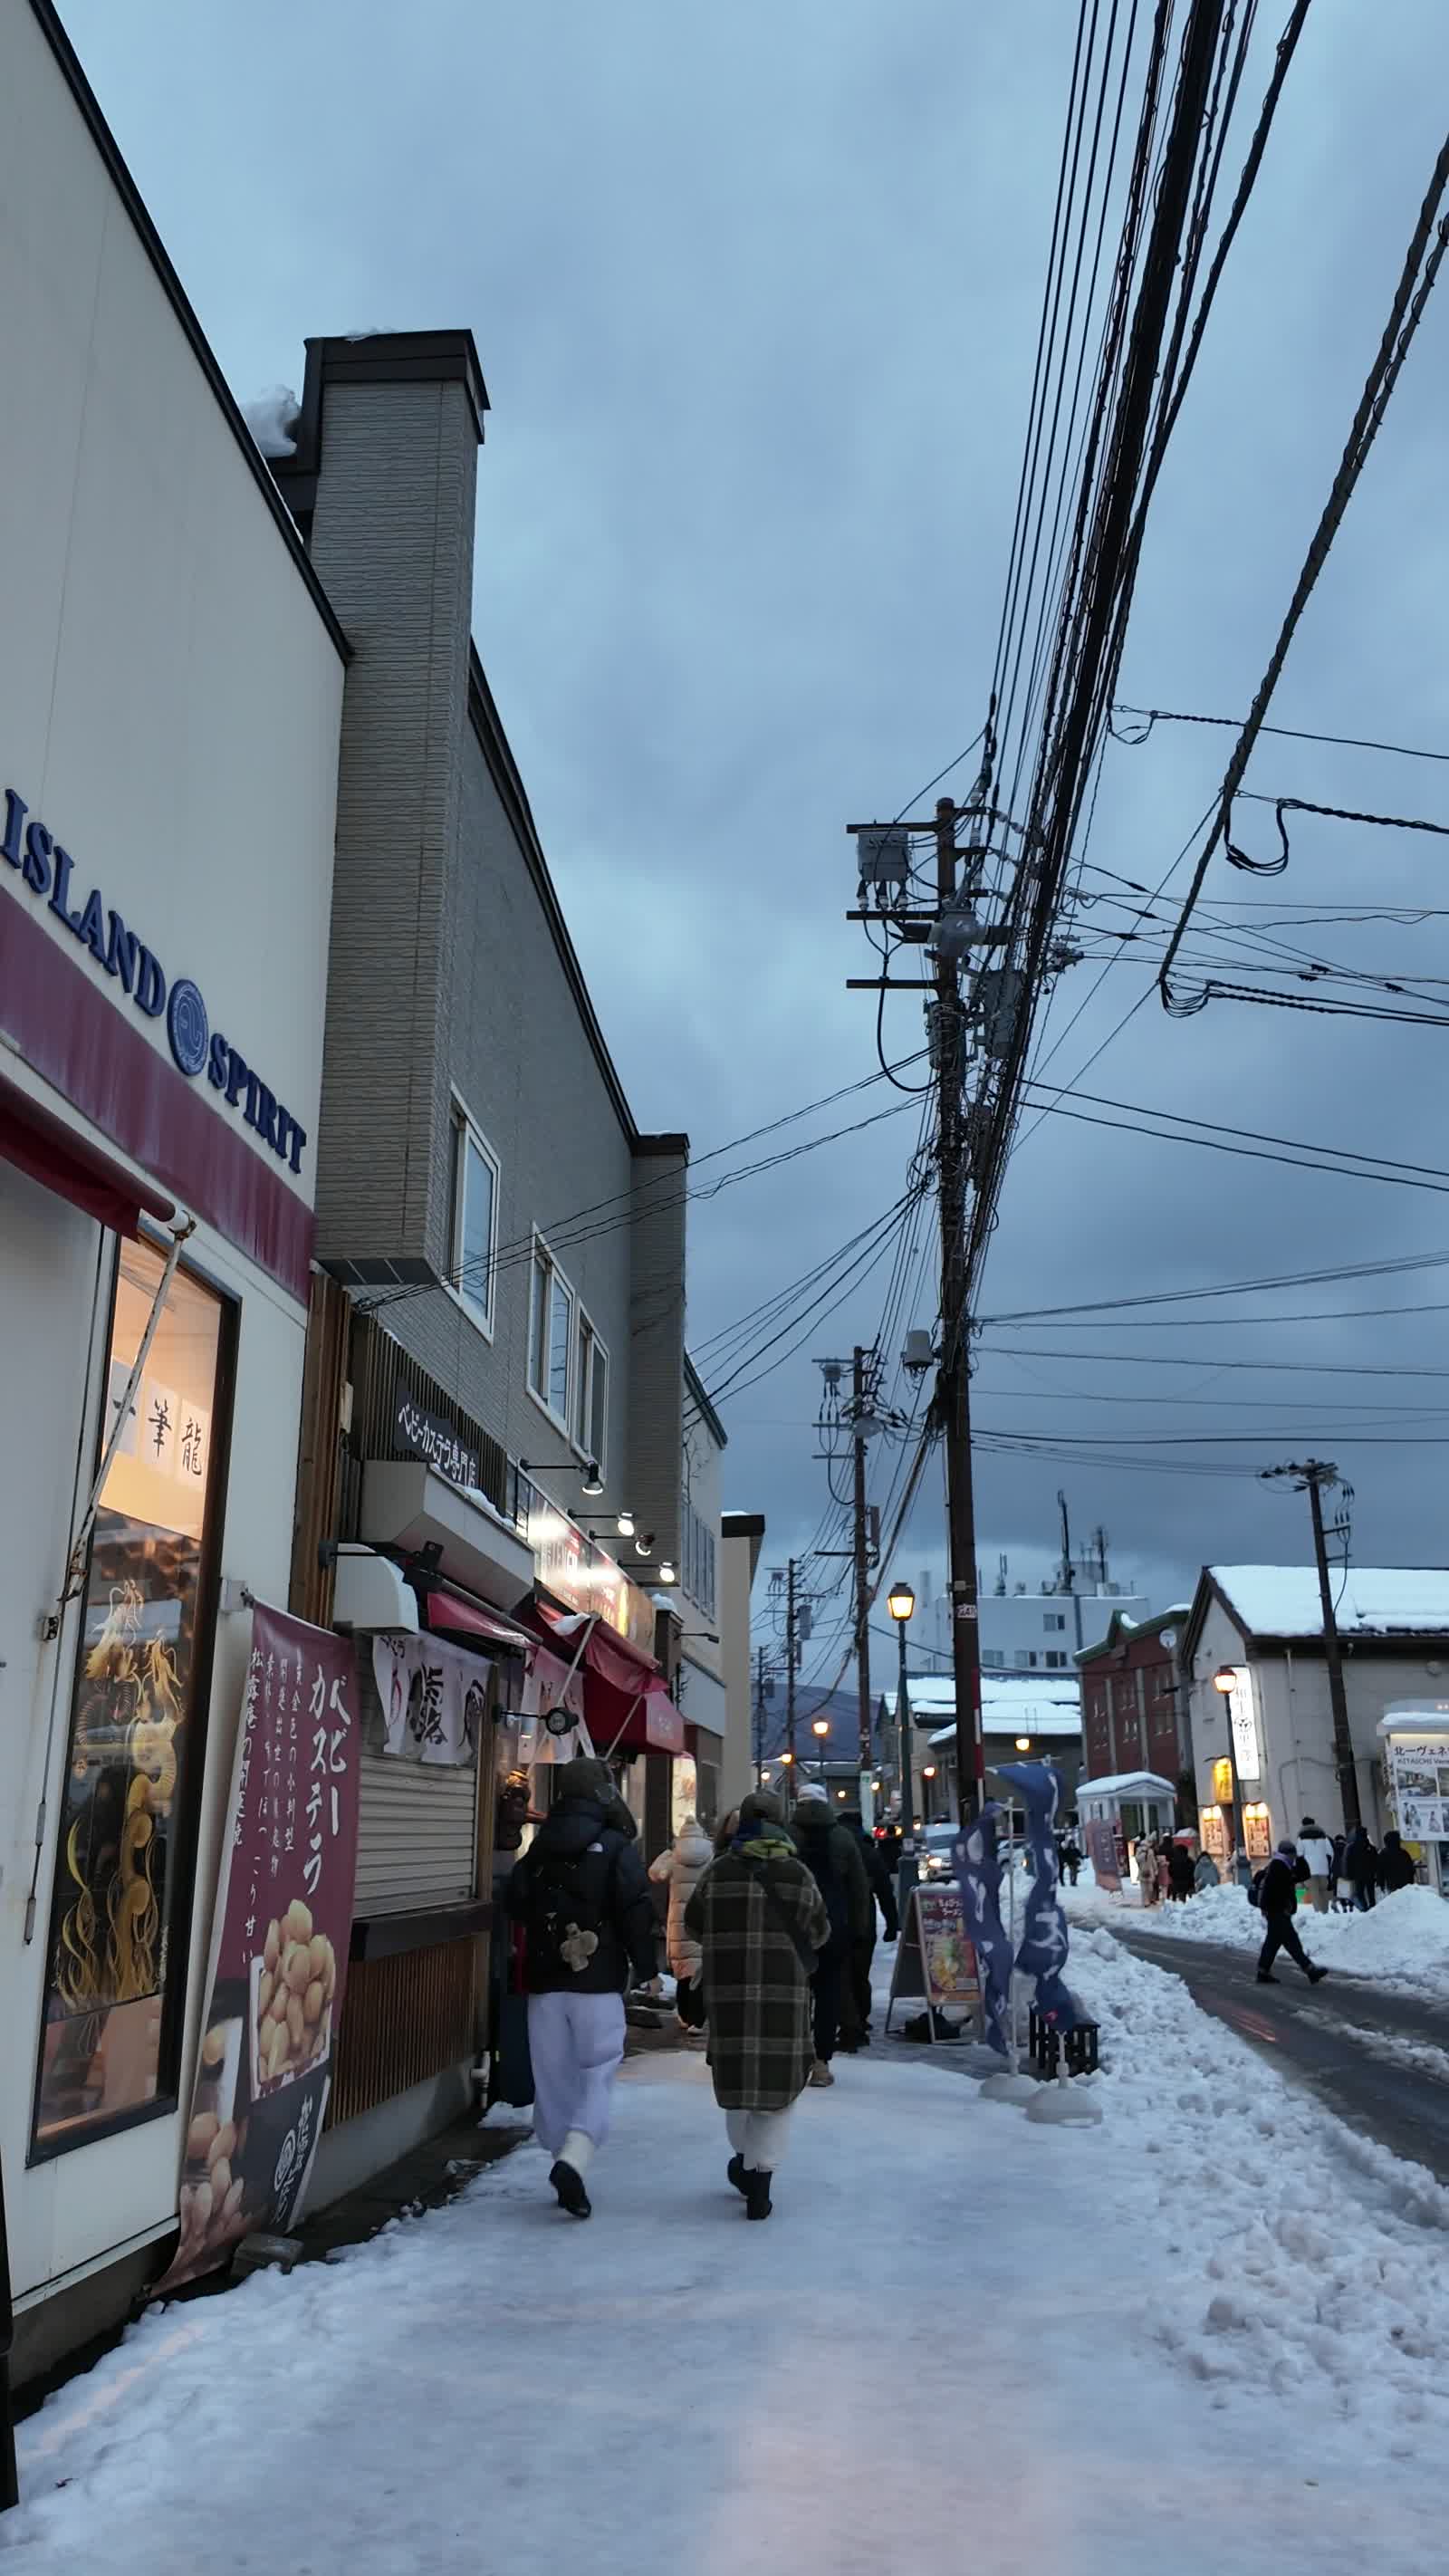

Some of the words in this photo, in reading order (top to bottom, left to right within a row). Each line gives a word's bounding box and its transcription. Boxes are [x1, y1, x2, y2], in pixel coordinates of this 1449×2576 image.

[1, 788, 166, 1017] ISLAND
[207, 1033, 307, 1174] SPIRIT
[1395, 1745, 1449, 1756] 北一ヴェネ
